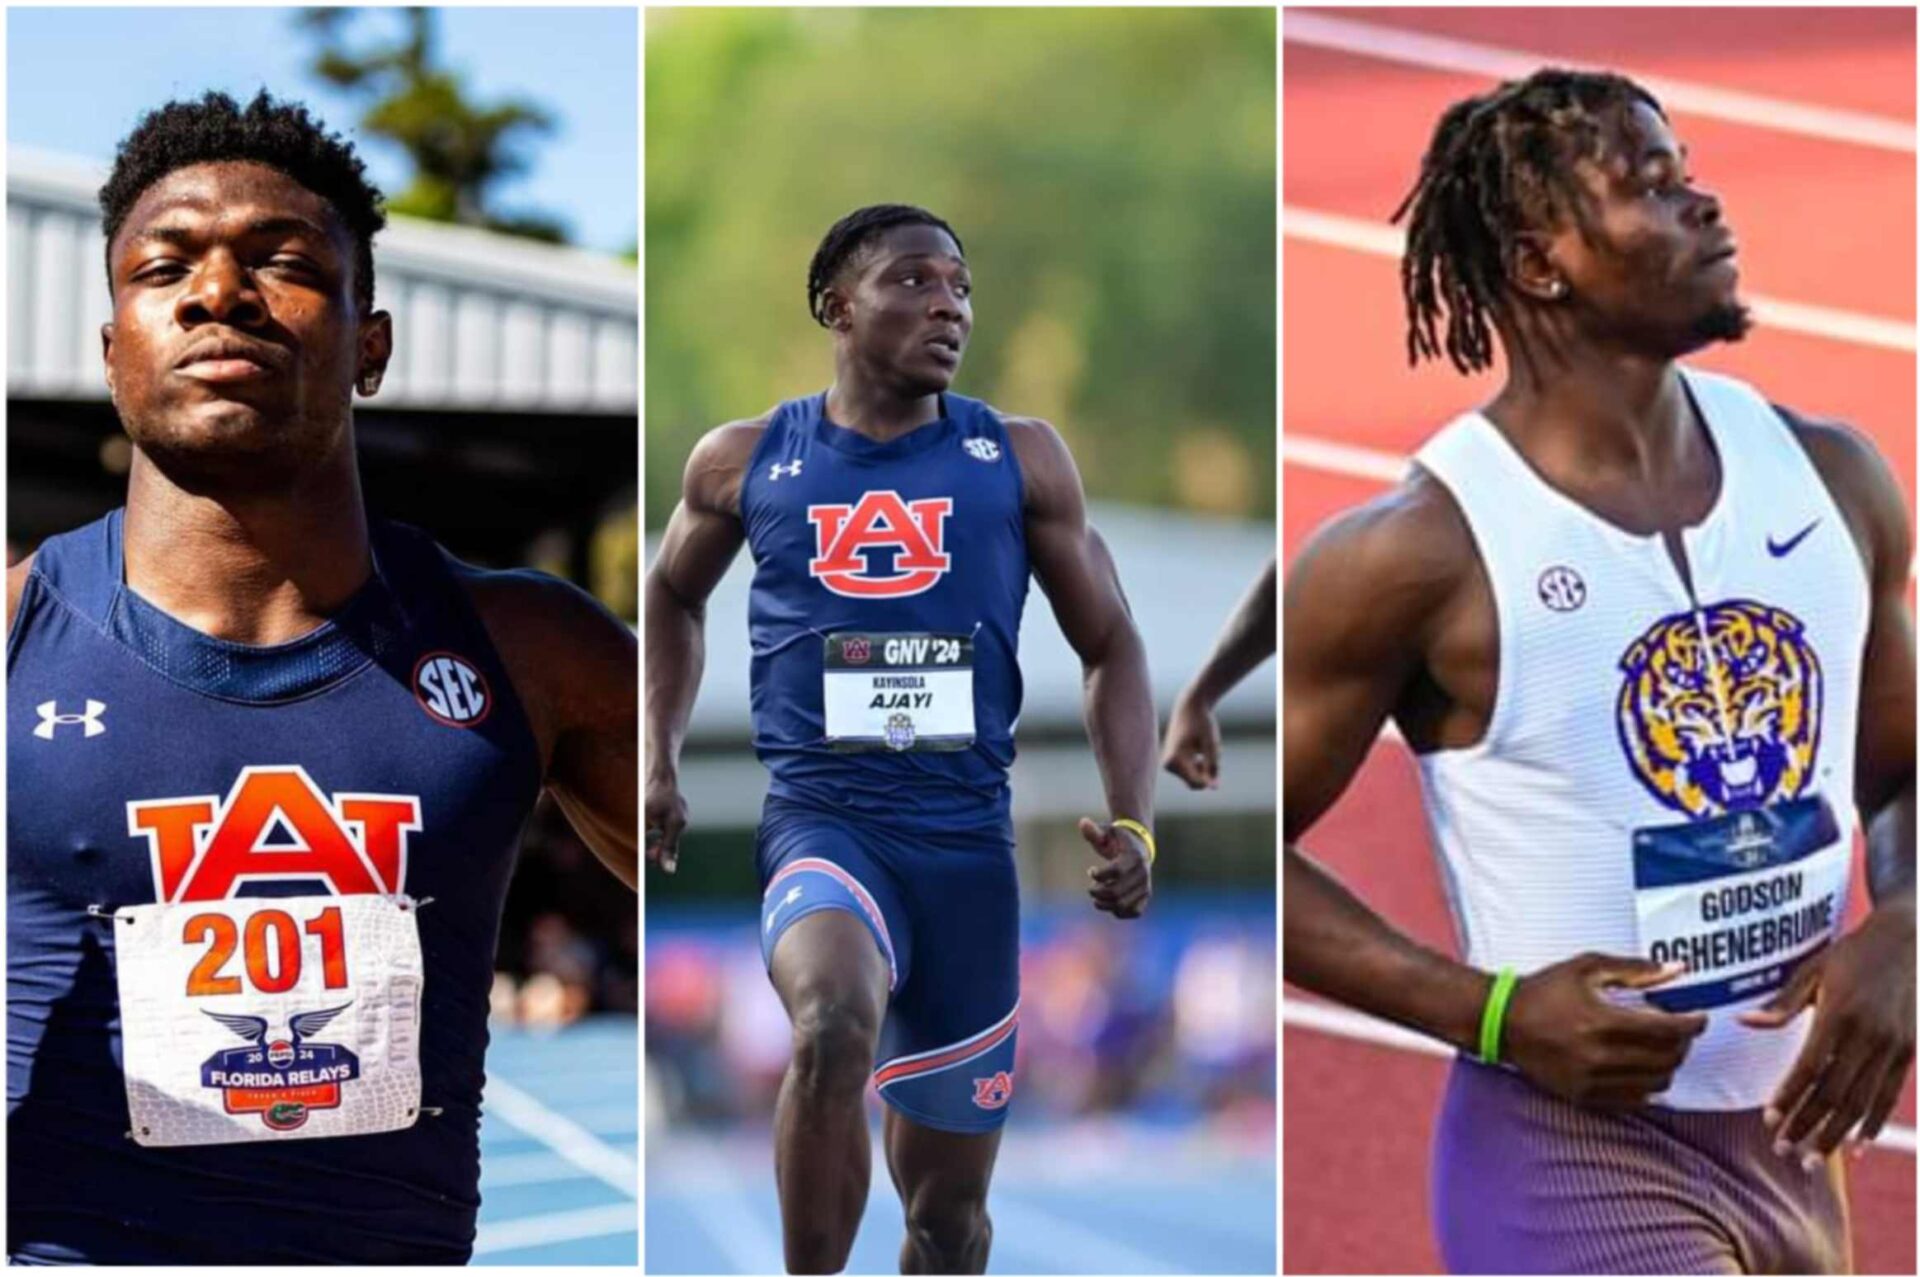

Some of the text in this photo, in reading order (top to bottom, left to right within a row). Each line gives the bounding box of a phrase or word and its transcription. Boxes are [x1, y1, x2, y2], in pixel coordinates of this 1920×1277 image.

[962, 436, 1000, 461] SEC
[1540, 568, 1585, 610] SEC
[884, 639, 961, 664] GNV '24
[418, 657, 485, 720] SEC
[873, 676, 926, 689] KAYINSOLA
[869, 693, 933, 709] AJAYI
[1701, 871, 1803, 922] GODSON
[182, 906, 349, 997] 201
[247, 1053, 263, 1063] 20
[299, 1050, 315, 1060] 24
[210, 1064, 351, 1087] FLORIDA RELAYS
